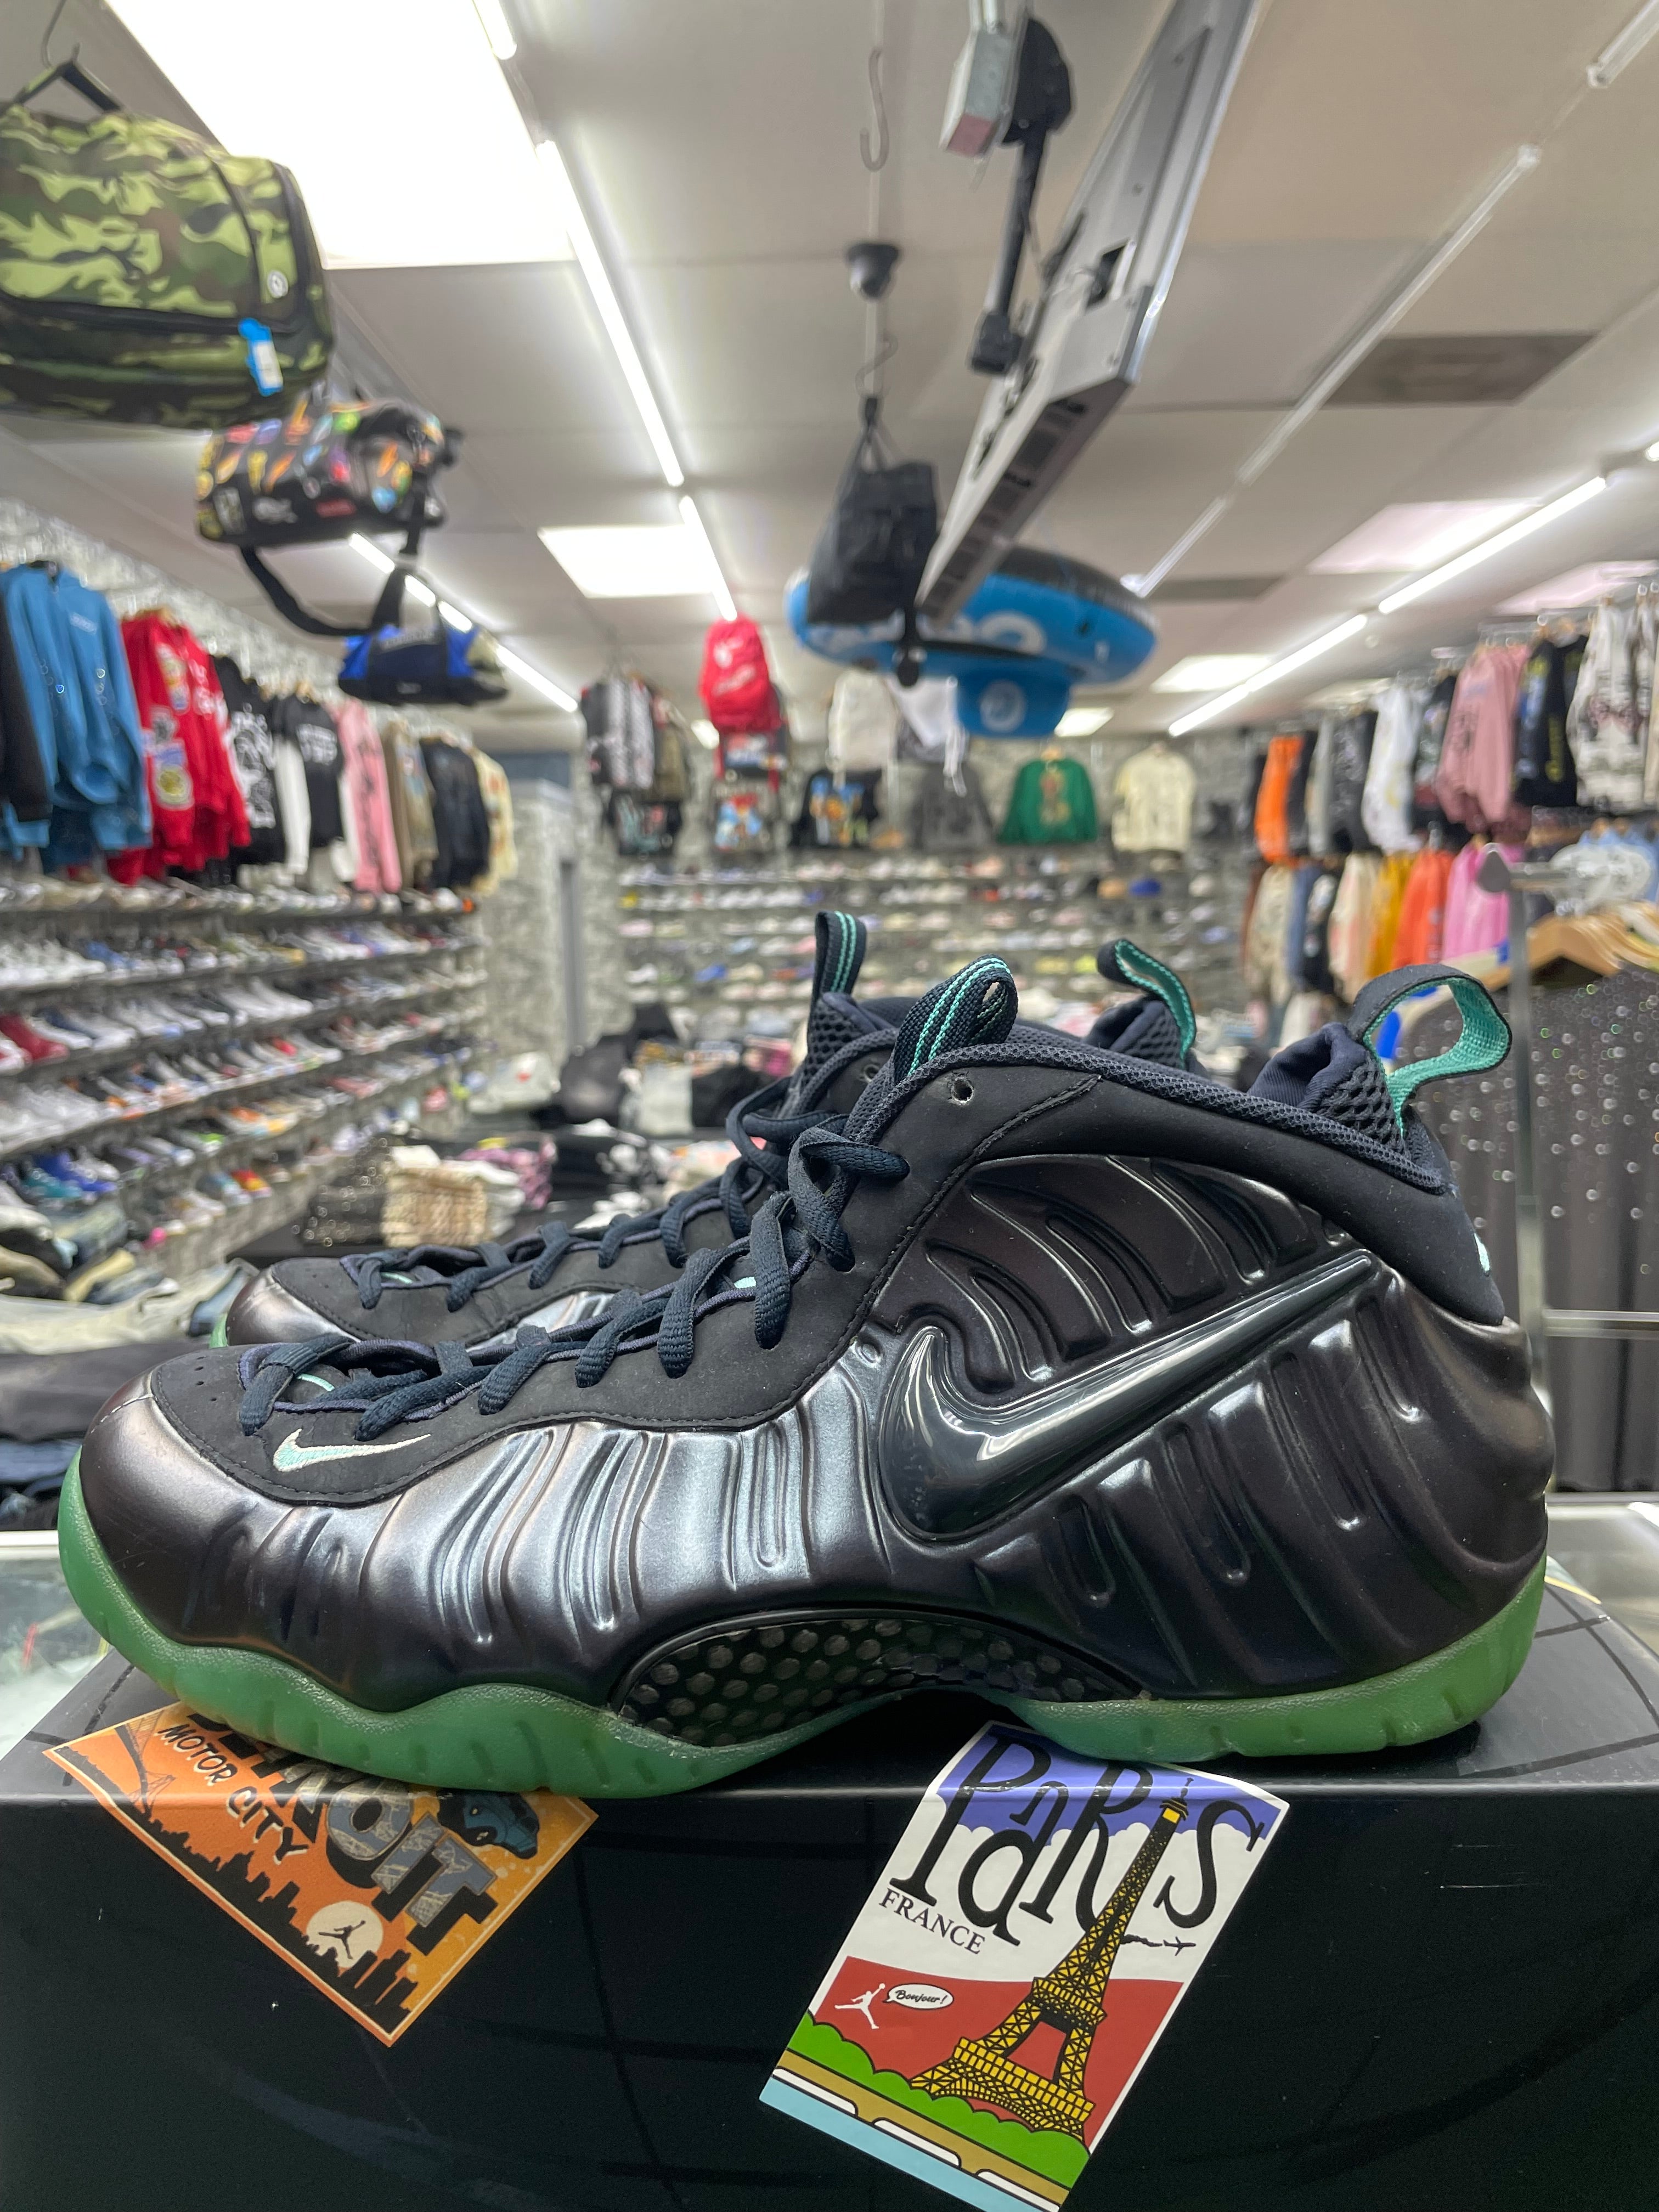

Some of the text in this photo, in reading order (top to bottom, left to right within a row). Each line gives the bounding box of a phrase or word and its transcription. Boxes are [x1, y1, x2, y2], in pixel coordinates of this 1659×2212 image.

[158, 1724, 308, 1865] MOTOR CITY
[878, 1887, 985, 1954] FRANCE
[895, 1990, 948, 2004] Bonjour!
